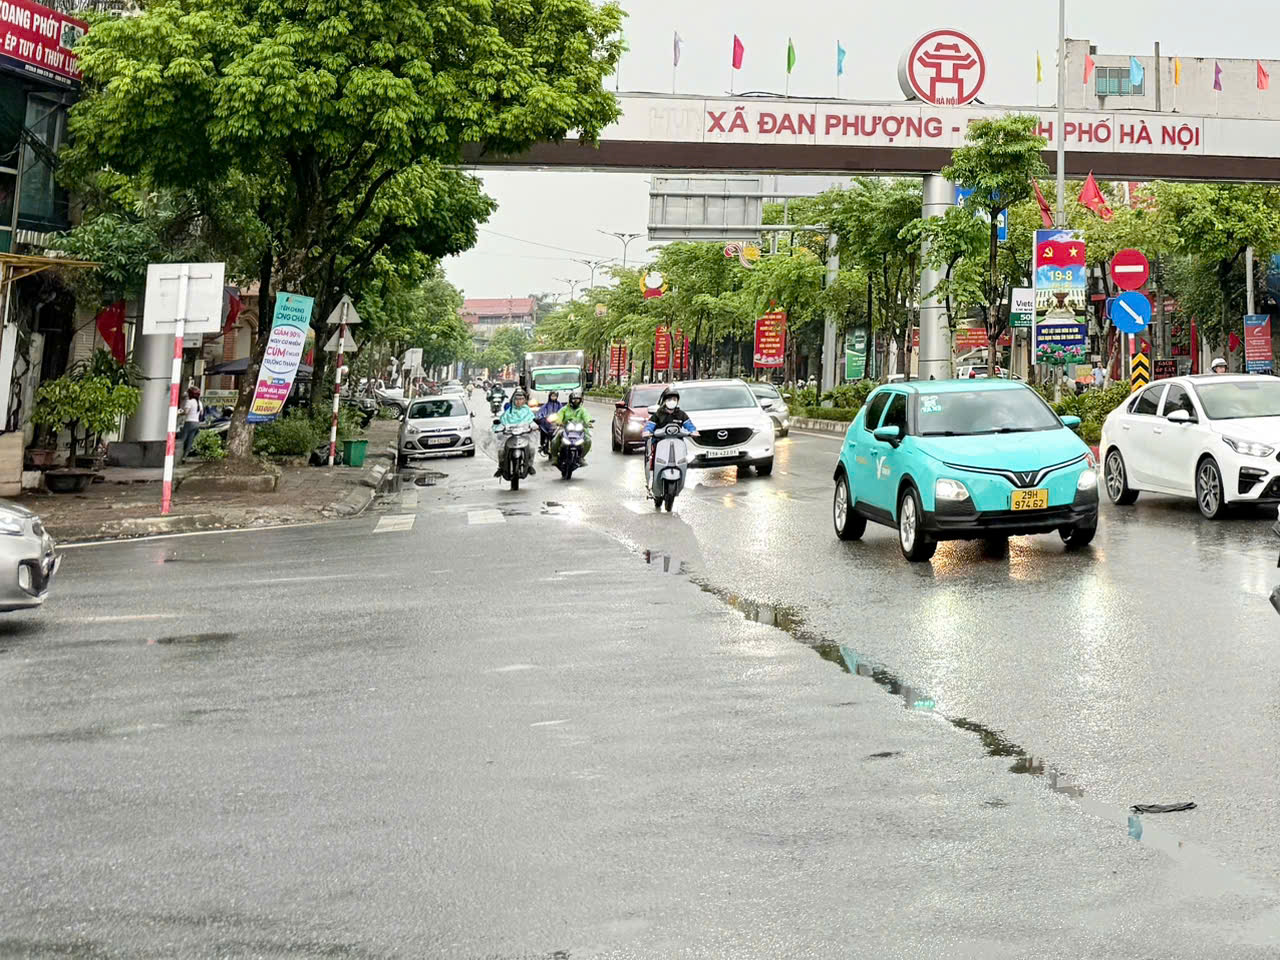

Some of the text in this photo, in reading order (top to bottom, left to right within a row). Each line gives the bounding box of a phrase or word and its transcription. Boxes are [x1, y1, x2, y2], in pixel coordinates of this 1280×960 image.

[0, 1, 59, 40] OANG PHỚT
[19, 38, 35, 58] TUY
[706, 106, 749, 133] XÃ
[757, 112, 816, 135] ĐAN
[825, 115, 943, 142] PHƯỢNG
[1063, 118, 1112, 144] PHỐ
[1119, 120, 1153, 145] HÀ
[1161, 123, 1200, 150] NỘI
[1049, 270, 1073, 281] 19-8
[1022, 490, 1038, 499] 29H
